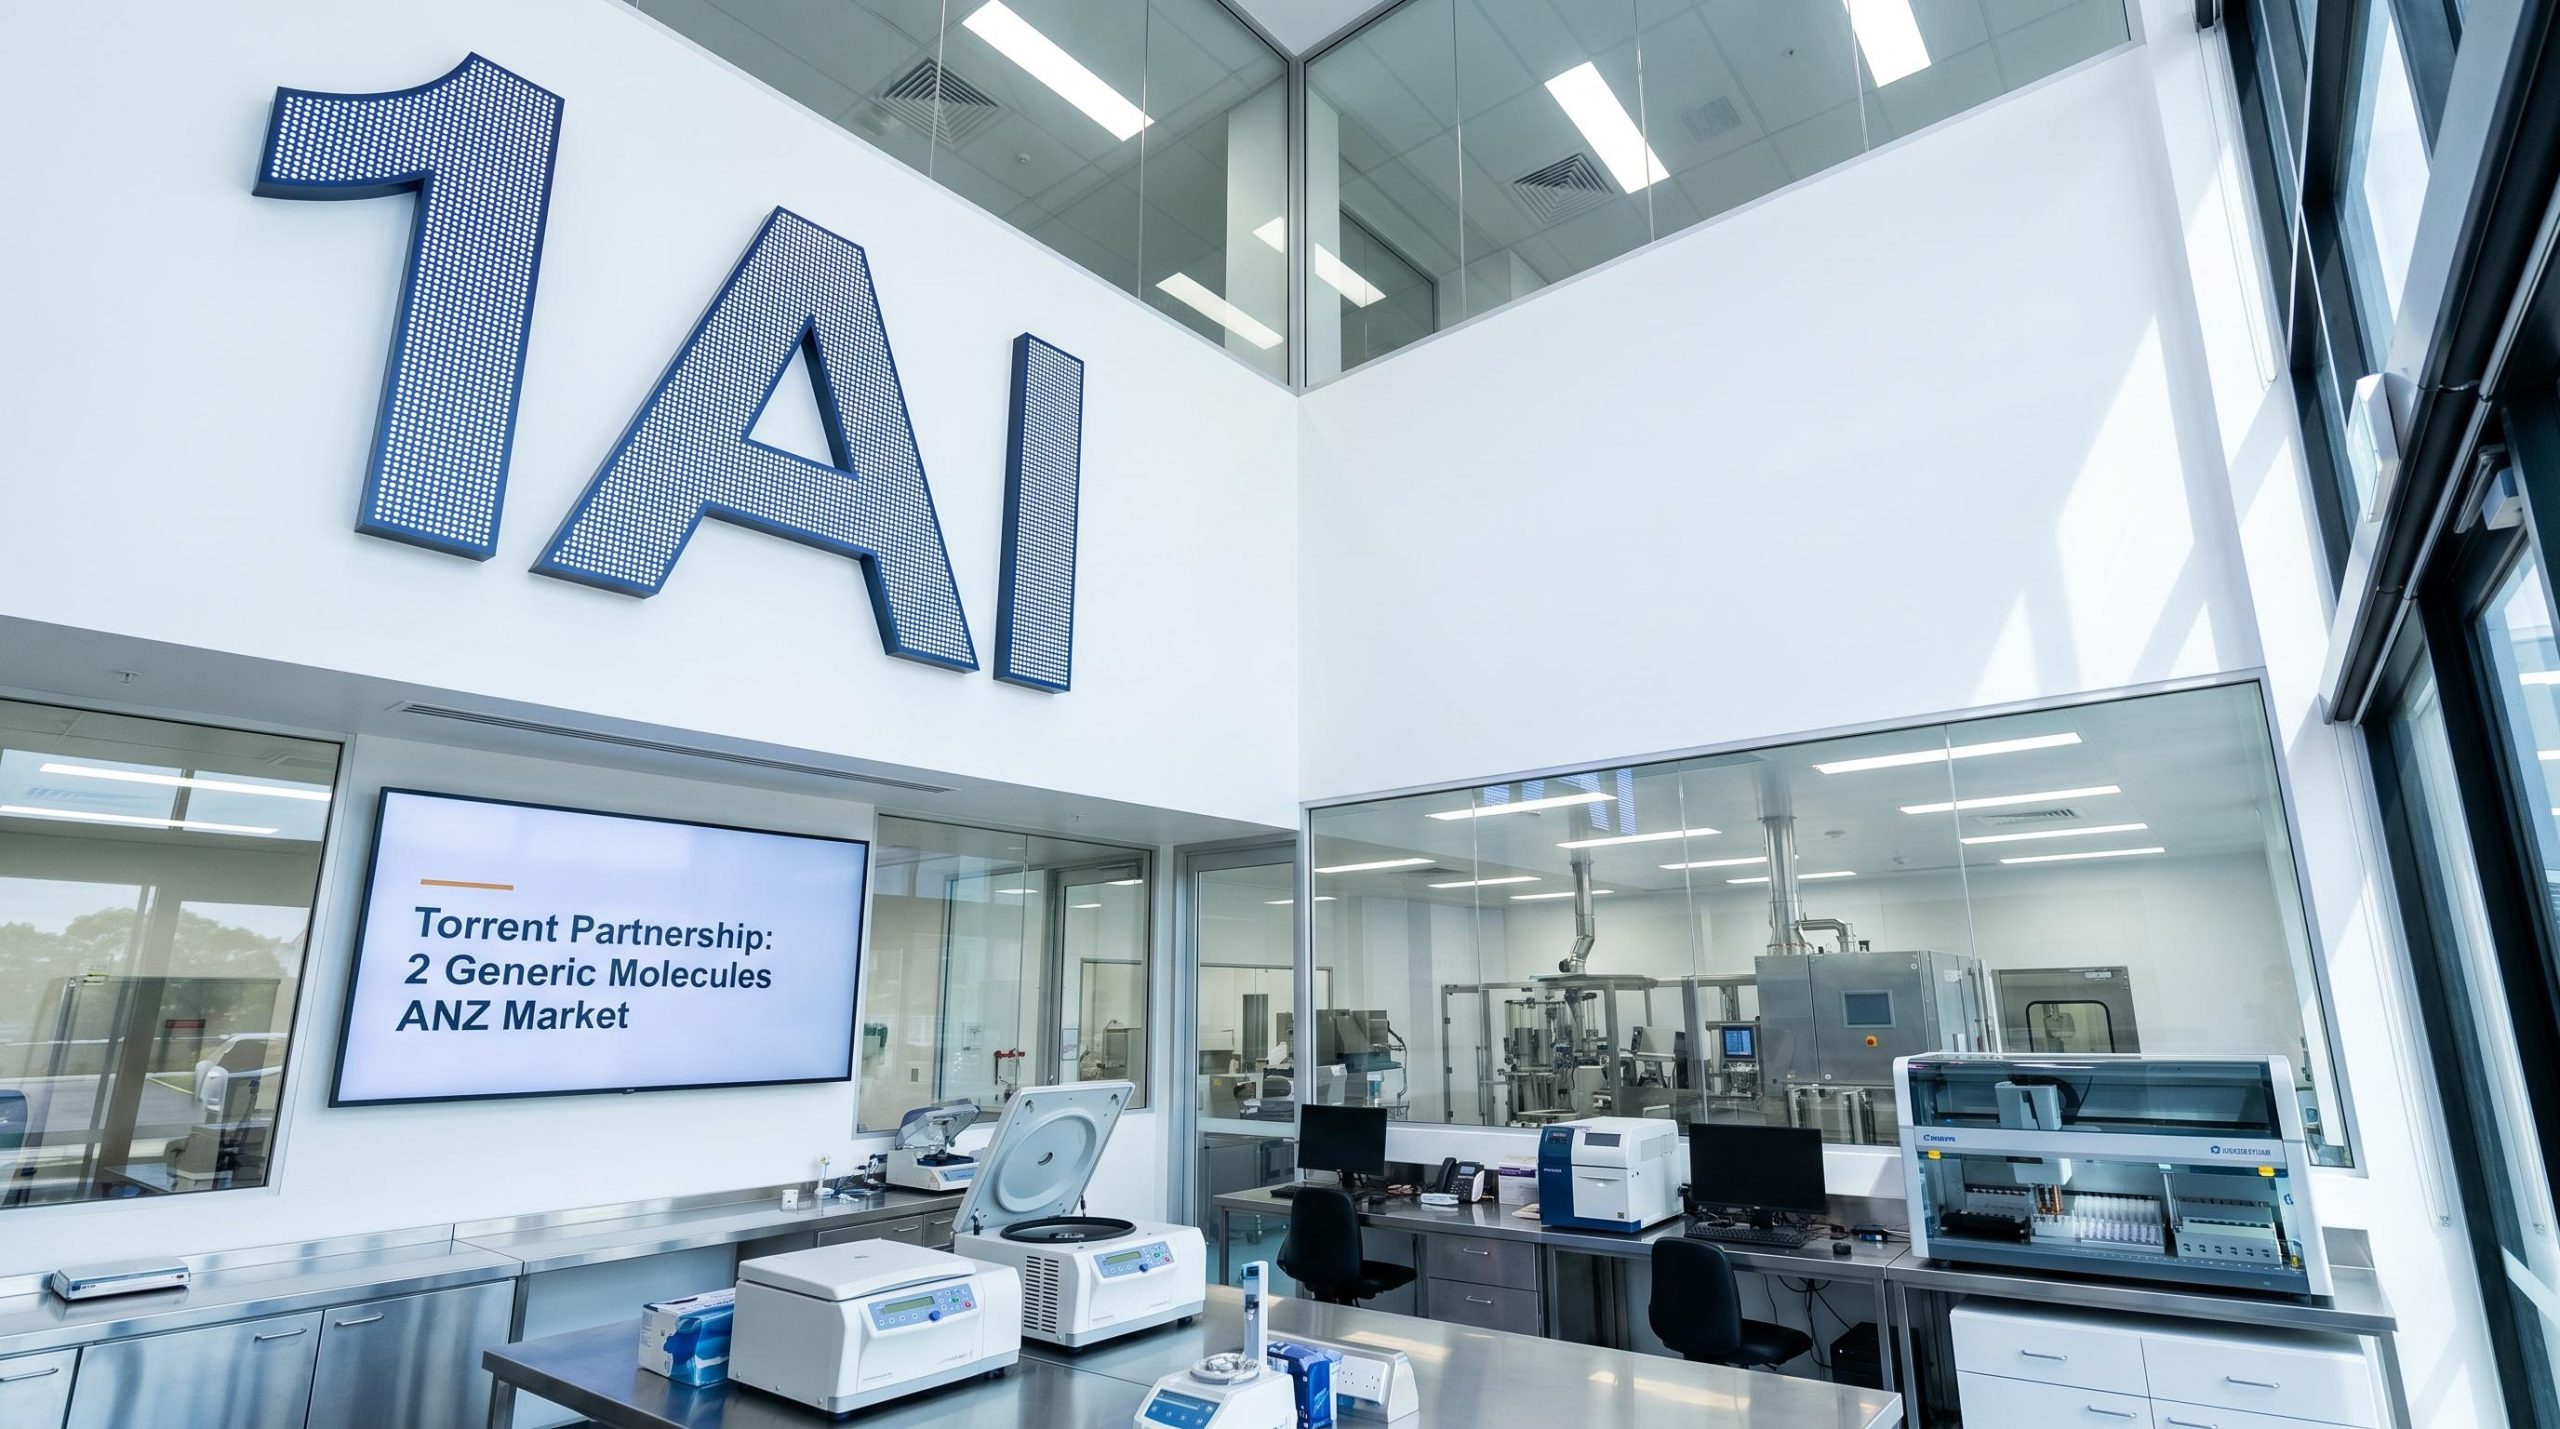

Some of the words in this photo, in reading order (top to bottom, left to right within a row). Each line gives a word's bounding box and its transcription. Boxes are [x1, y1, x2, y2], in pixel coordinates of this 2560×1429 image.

[414, 905, 559, 943] Torrent
[571, 915, 773, 957] Partnership:
[404, 953, 431, 985] 2
[445, 953, 597, 987] Generic
[609, 958, 772, 989] Molecules
[396, 999, 491, 1032] ANZ
[502, 999, 630, 1031] Market
